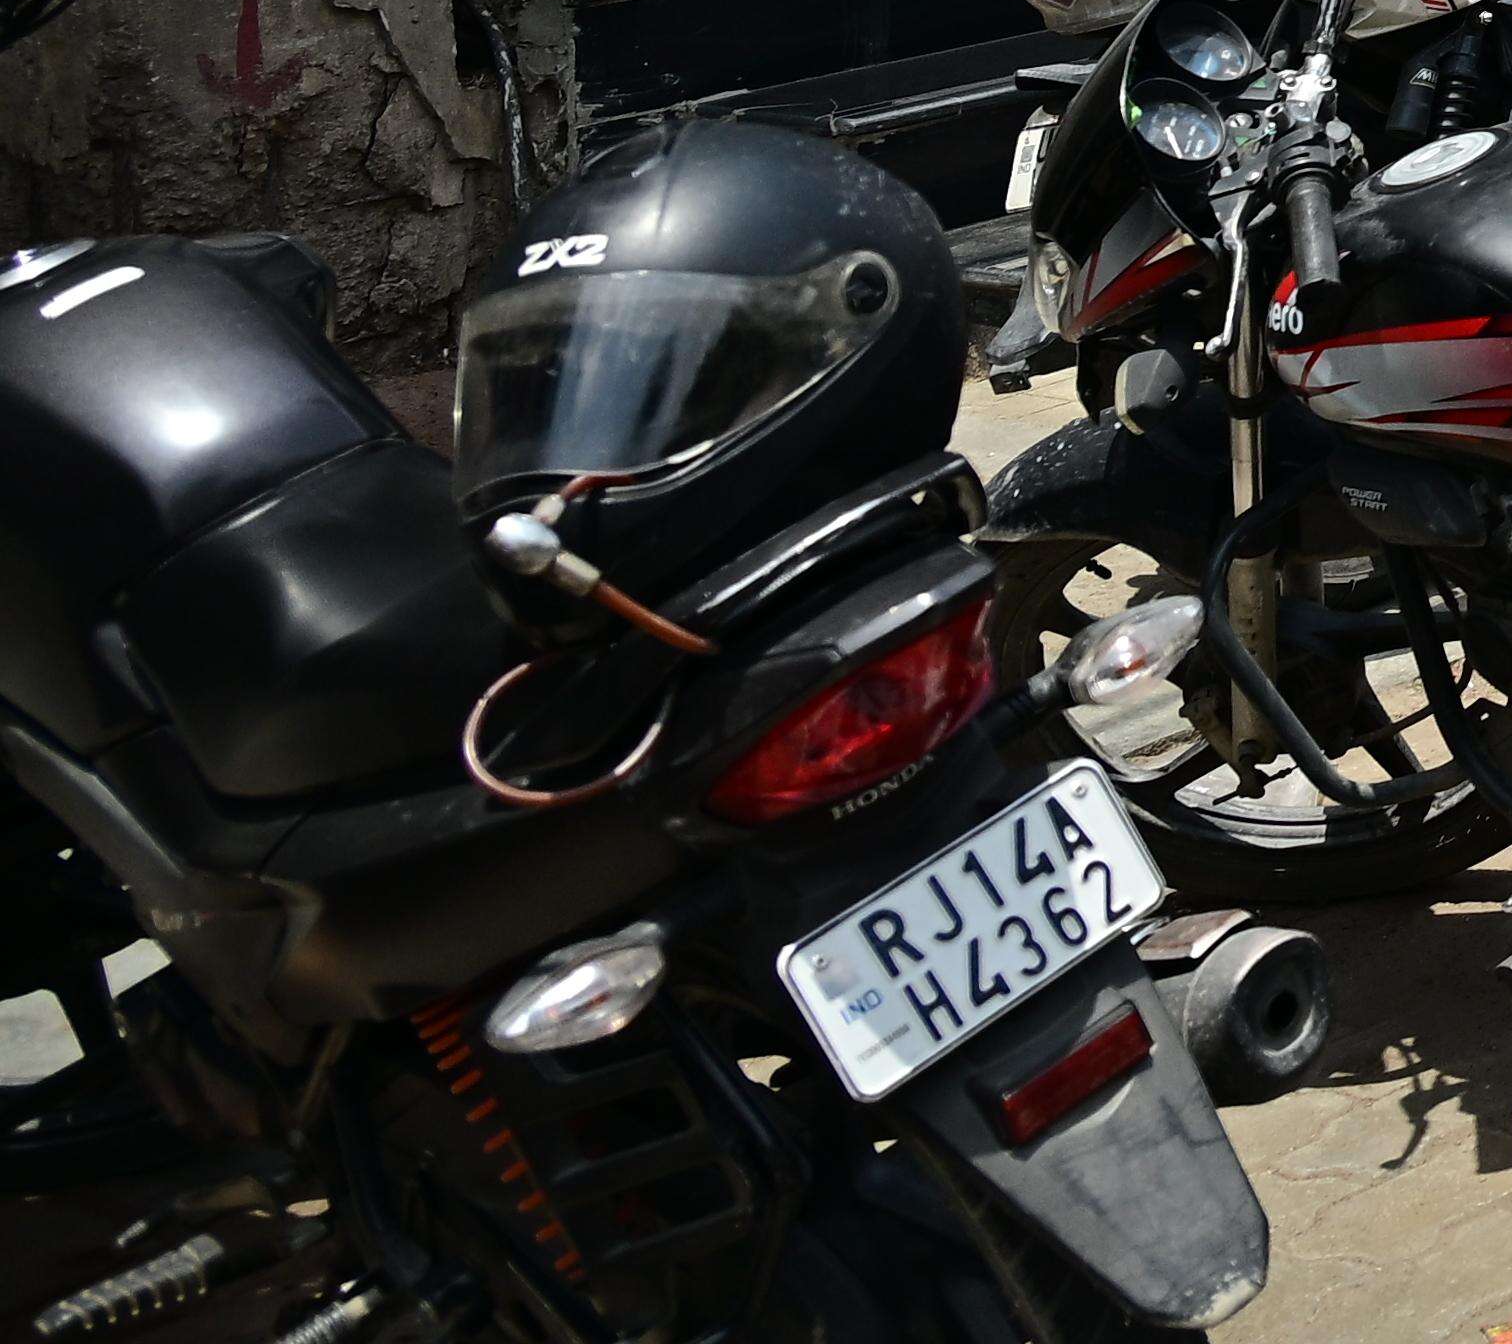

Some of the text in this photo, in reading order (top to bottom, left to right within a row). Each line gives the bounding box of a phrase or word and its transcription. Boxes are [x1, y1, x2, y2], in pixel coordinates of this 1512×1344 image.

[1342, 485, 1384, 502] POWER
[1350, 496, 1389, 514] START
[831, 752, 935, 821] HONDA
[857, 796, 1095, 979] RJ14A
[903, 859, 1133, 1043] H4362
[839, 986, 885, 1026] IND
